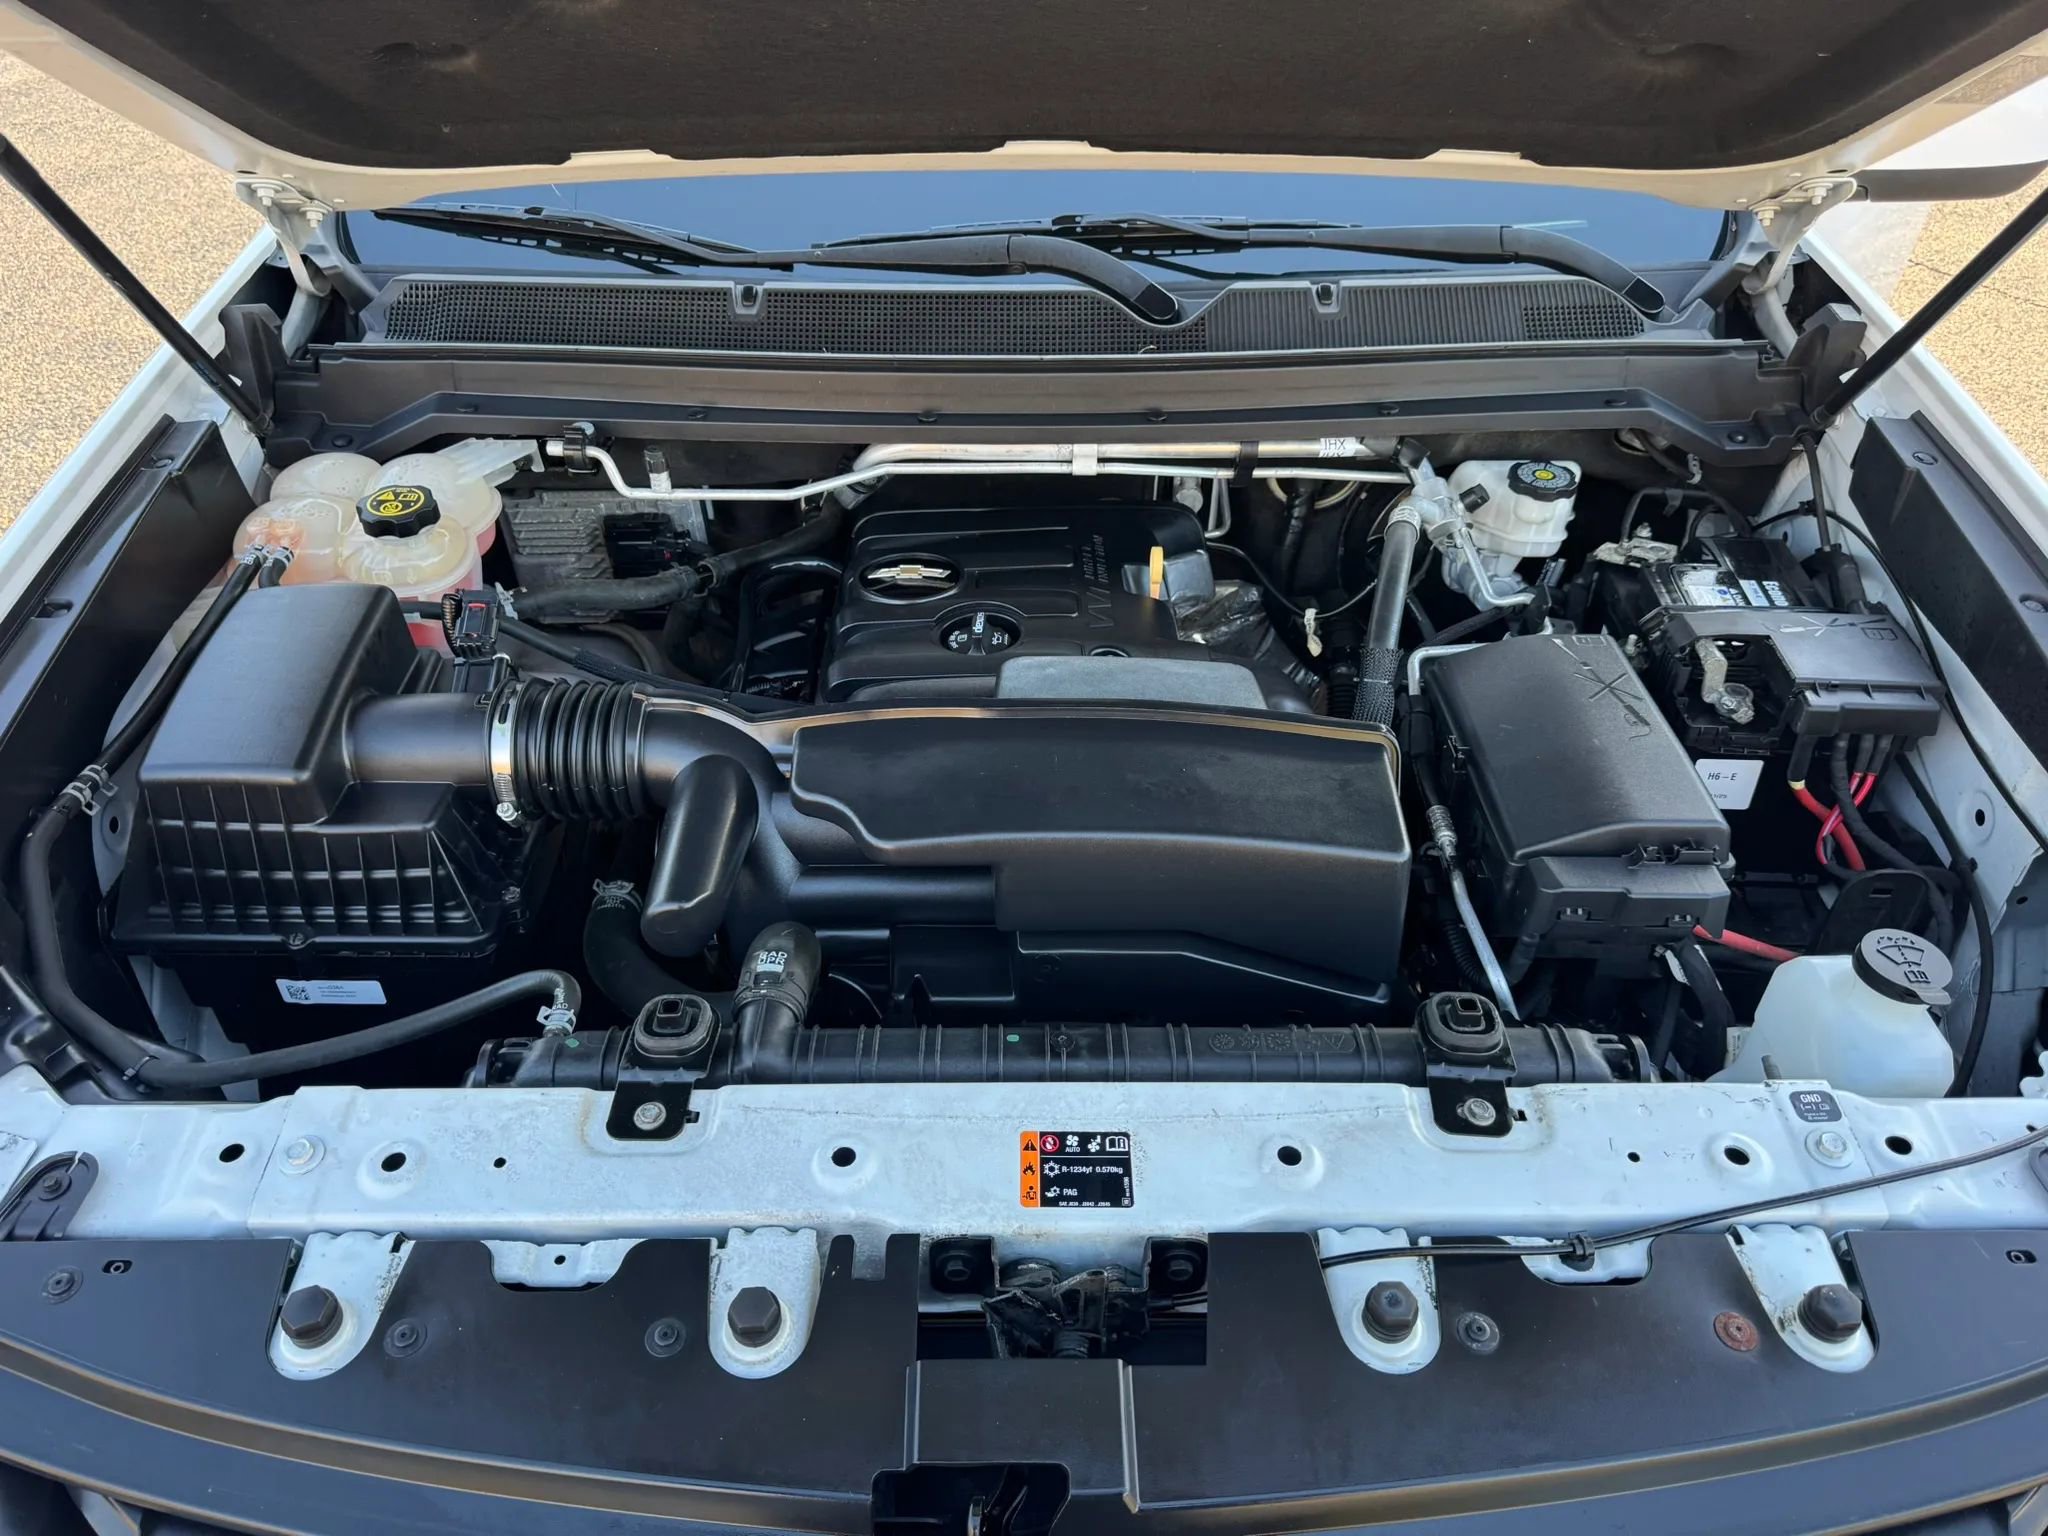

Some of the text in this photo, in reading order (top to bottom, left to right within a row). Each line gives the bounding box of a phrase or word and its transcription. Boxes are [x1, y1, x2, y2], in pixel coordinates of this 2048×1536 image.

[1799, 1093, 1822, 1103] GND
[1061, 1166, 1123, 1174] R-1234yf 0.570kg
[1063, 1188, 1078, 1196] PAG
